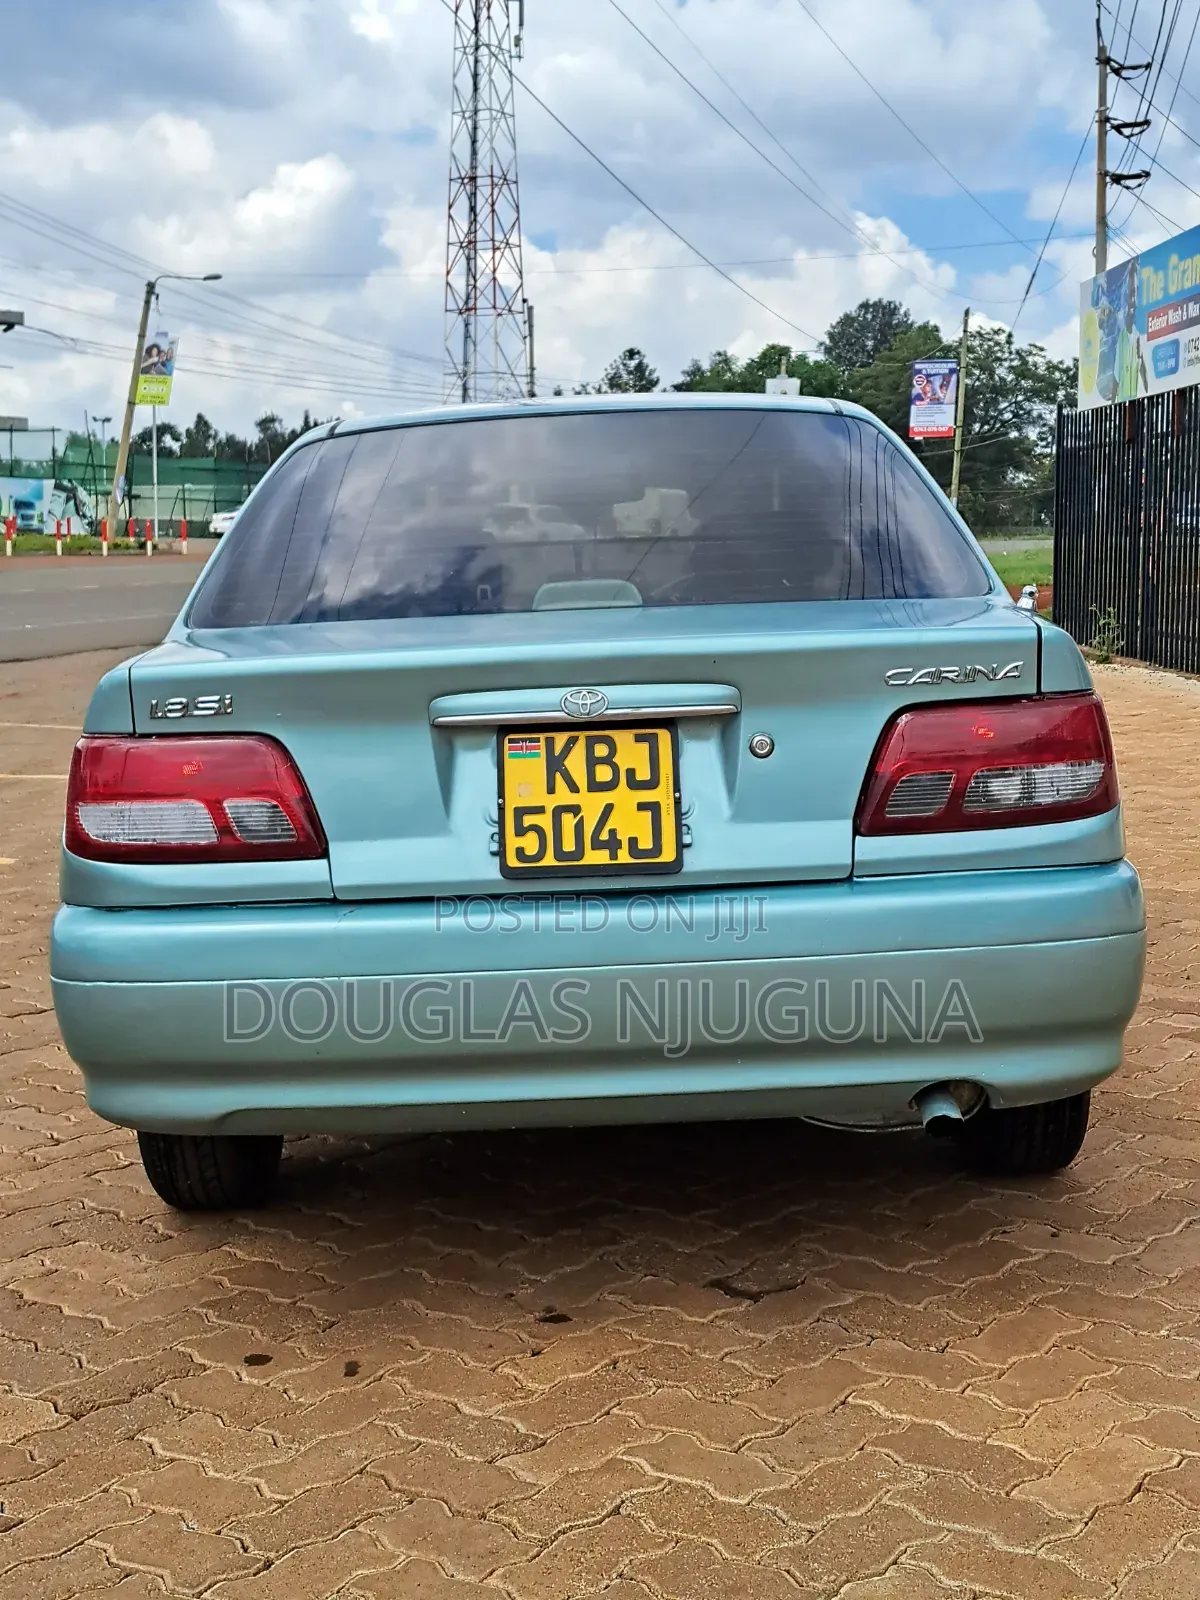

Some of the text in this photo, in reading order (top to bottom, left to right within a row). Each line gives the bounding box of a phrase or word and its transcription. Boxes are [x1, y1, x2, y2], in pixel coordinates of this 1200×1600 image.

[1141, 266, 1164, 306] The
[1148, 312, 1168, 333] Exterior
[1168, 306, 1182, 325] Wash
[1188, 301, 1200, 319] Wax
[885, 661, 1024, 686] CARINA
[545, 732, 660, 795] KBJ
[513, 801, 663, 863] 504J
